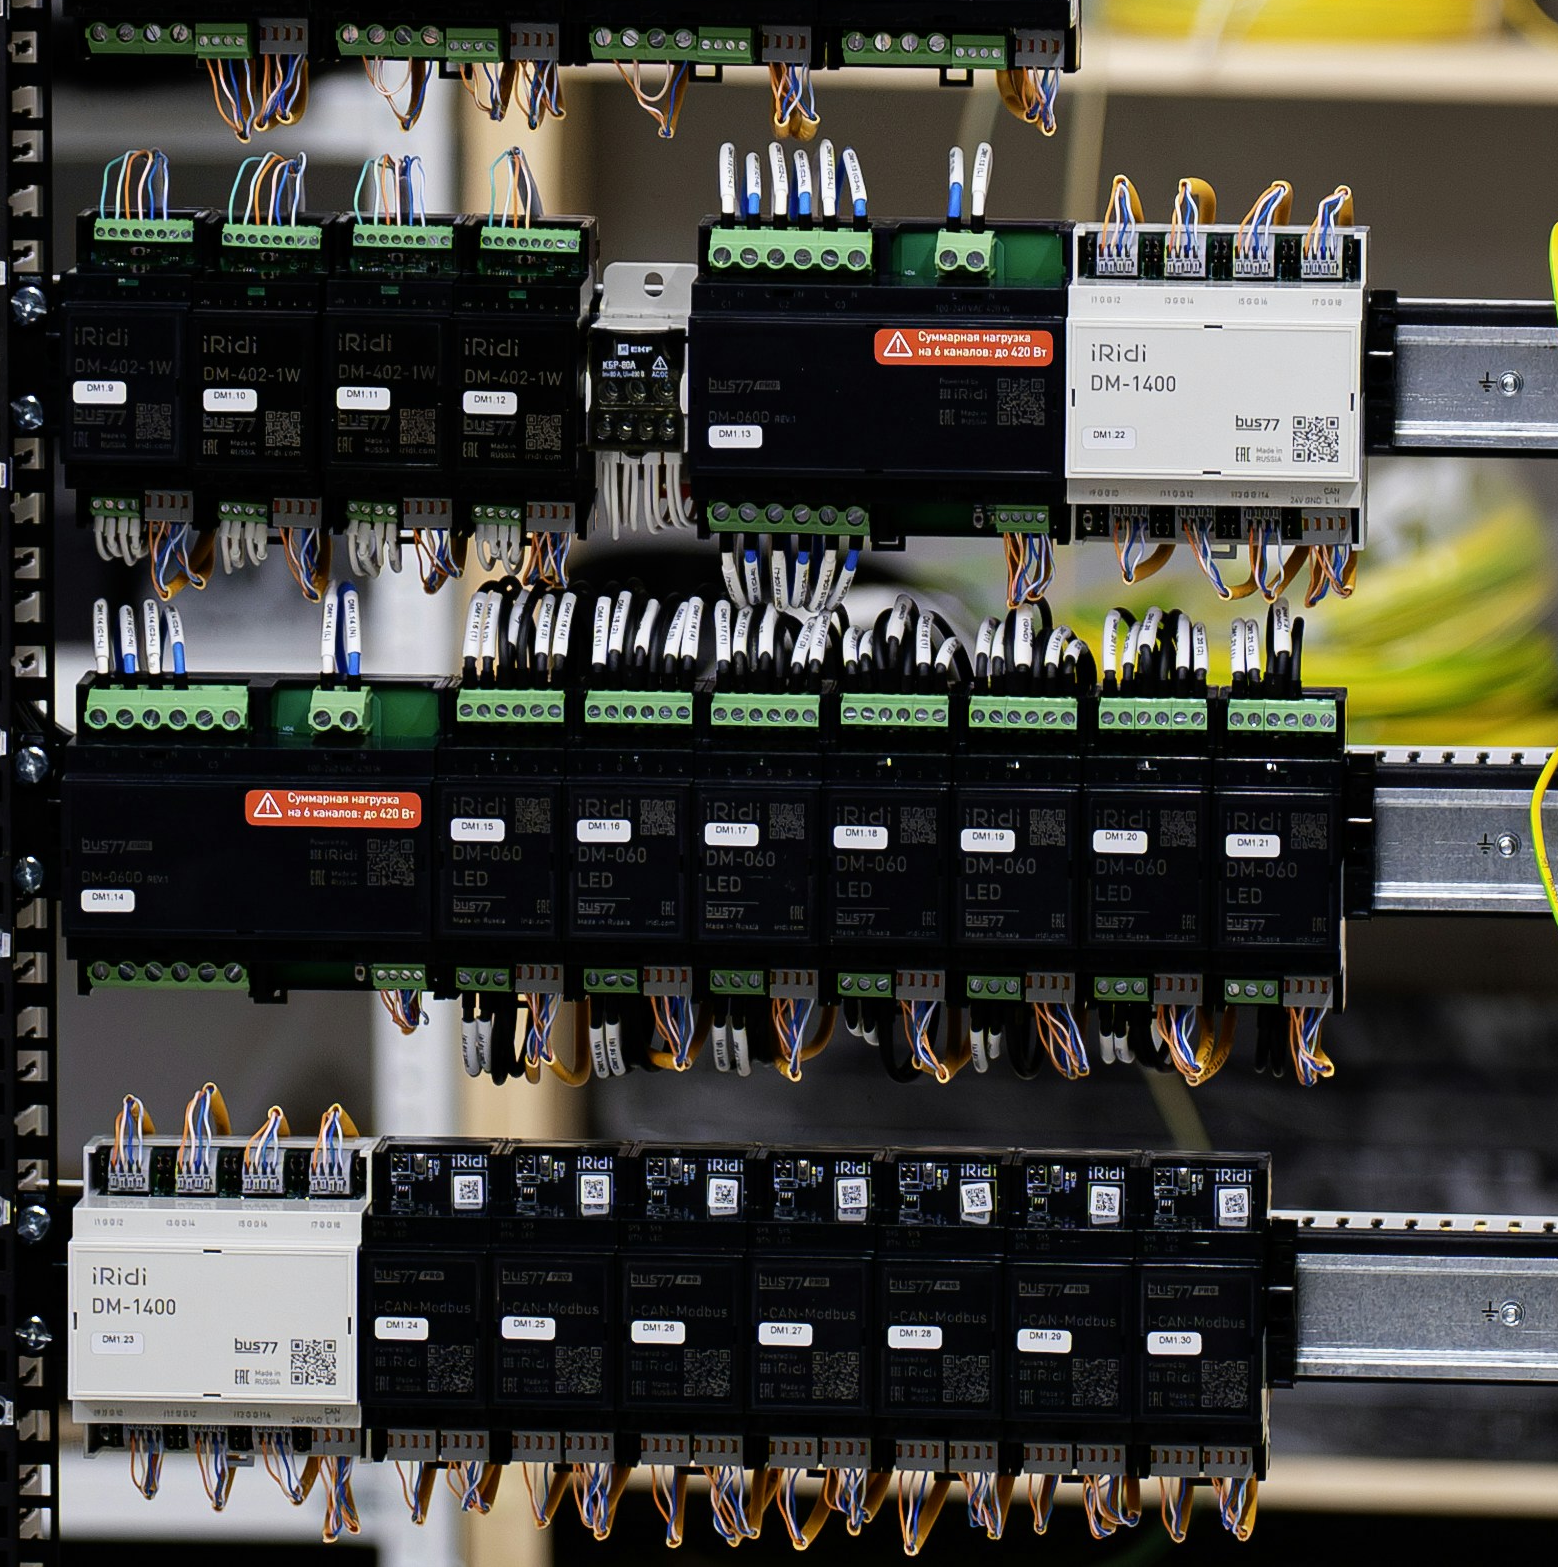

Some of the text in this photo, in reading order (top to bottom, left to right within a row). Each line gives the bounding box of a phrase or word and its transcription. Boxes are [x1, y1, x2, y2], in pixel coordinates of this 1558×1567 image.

[75, 327, 128, 346] iRidi
[338, 333, 391, 352] iRidi
[918, 331, 1031, 344] Суммарная нагрузка
[203, 336, 257, 353] iRidi
[465, 338, 518, 357] iRidi
[919, 346, 1046, 358] на 6 каналов: до 420 Вт
[1091, 344, 1147, 362] iRidi
[75, 359, 172, 375] DM-402-1W
[204, 367, 300, 382] DM-402-1W
[339, 364, 435, 380] DM-402-1W
[465, 369, 562, 385] DM-402-1W
[1091, 375, 1176, 392] DM-1400
[87, 384, 114, 392] DM1.9
[347, 390, 377, 398] DM1.11
[474, 396, 505, 404] DM1.12
[1235, 415, 1280, 431] bus77
[719, 430, 751, 438] DM1.13
[1093, 430, 1125, 439] DM1.22
[287, 793, 399, 806] Суммарная нагрузка
[453, 797, 507, 815] iRidi
[287, 807, 415, 819] на 6 каналов: до 420 Вт
[578, 799, 631, 817] iRidi
[706, 802, 760, 821] iRidi
[837, 807, 891, 825] iRidi
[965, 809, 1020, 827] iRidi
[1096, 809, 1151, 827] iRidi
[1227, 812, 1281, 831] iRidi
[461, 822, 493, 830] DM1.15
[588, 822, 619, 830] DM1.16
[715, 826, 747, 834] DM1.17
[845, 829, 877, 837] DM1.18
[972, 832, 1004, 841] DM1.19
[1105, 832, 1137, 841] DM1.20
[1237, 839, 1269, 847] DM1.21
[453, 845, 522, 861] DM-060
[578, 847, 646, 862] DM-060
[706, 850, 775, 866] DM-060
[837, 856, 906, 872] DM-060
[965, 858, 1036, 874] DM-060
[1096, 859, 1167, 875] DM-060
[1227, 861, 1297, 877] DM-060
[453, 871, 488, 886] LED
[578, 872, 613, 888] LED
[706, 876, 741, 892] LED
[92, 893, 124, 901] DM1.14
[836, 882, 872, 898] LED
[965, 884, 1001, 901] LED
[1096, 885, 1132, 902] LED
[1227, 887, 1262, 904] LED
[452, 1155, 487, 1167] iRidi
[578, 1156, 612, 1169] iRidi
[708, 1159, 743, 1172] iRidi
[835, 1162, 871, 1174] iRidi
[961, 1164, 996, 1177] iRidi
[1089, 1167, 1124, 1179] iRidi
[1216, 1169, 1251, 1182] iRidi
[92, 1267, 147, 1285] iRidi
[93, 1298, 176, 1315] DM-1400
[386, 1321, 418, 1329] DM1.24
[513, 1319, 545, 1327] DM1.25
[643, 1324, 675, 1332] DM1.26
[770, 1326, 802, 1335] DM1.27
[102, 1335, 134, 1344] DM1.23
[900, 1329, 931, 1337] DM1.28
[1029, 1332, 1061, 1340] DM1.29
[1159, 1336, 1191, 1344] DM1.30
[235, 1338, 278, 1353] bus77
